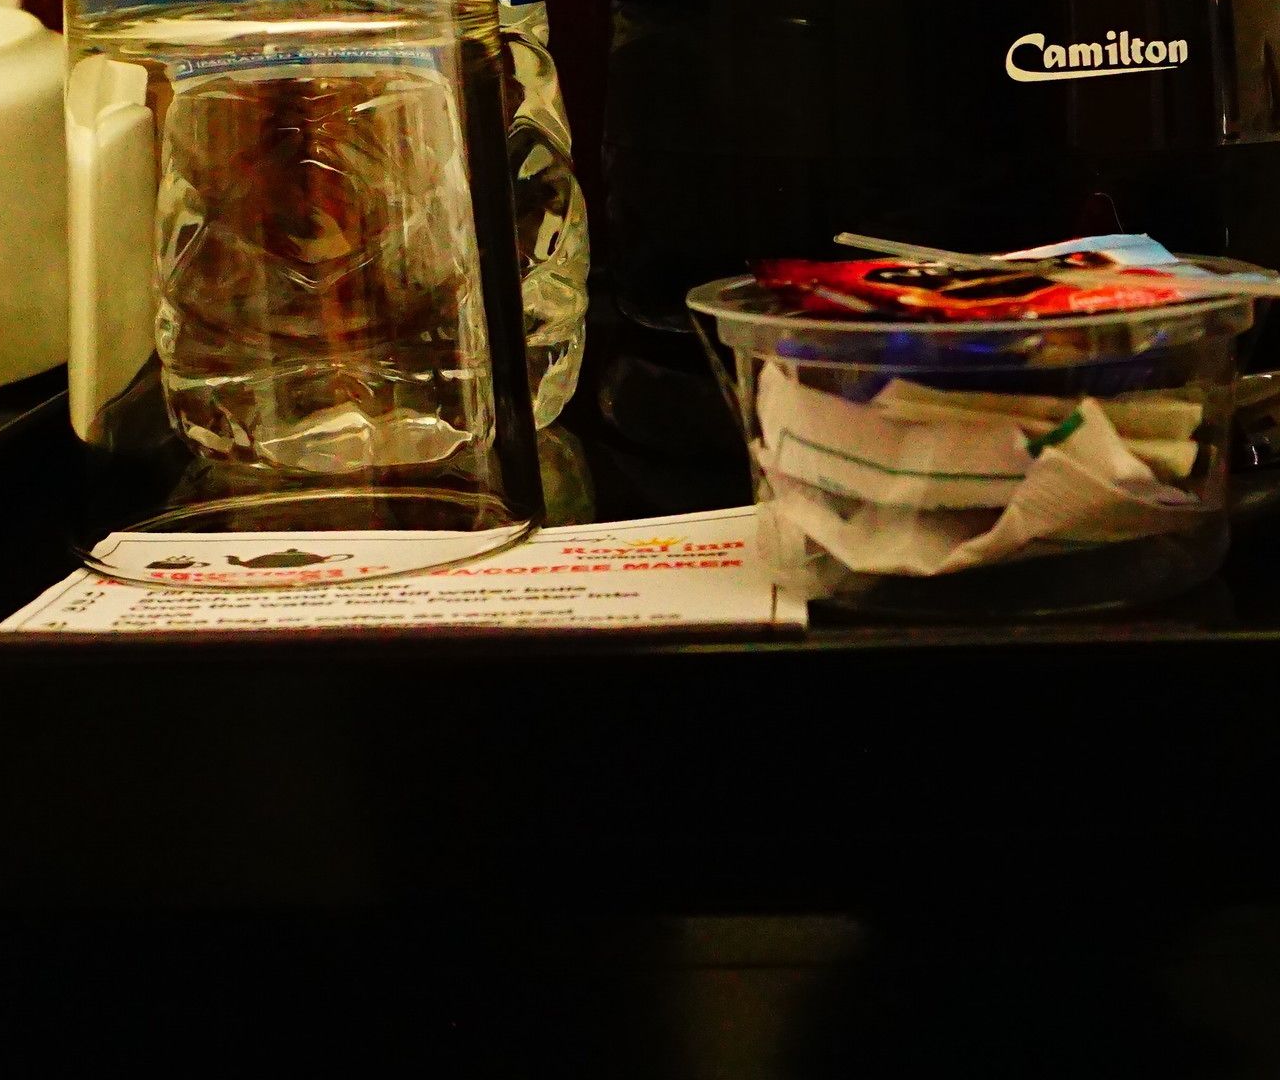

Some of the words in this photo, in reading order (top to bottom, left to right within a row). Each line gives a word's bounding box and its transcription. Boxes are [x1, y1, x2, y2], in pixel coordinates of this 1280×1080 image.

[1006, 30, 1188, 82] Camilton
[562, 544, 669, 556] Royal
[622, 559, 744, 570] MAKER
